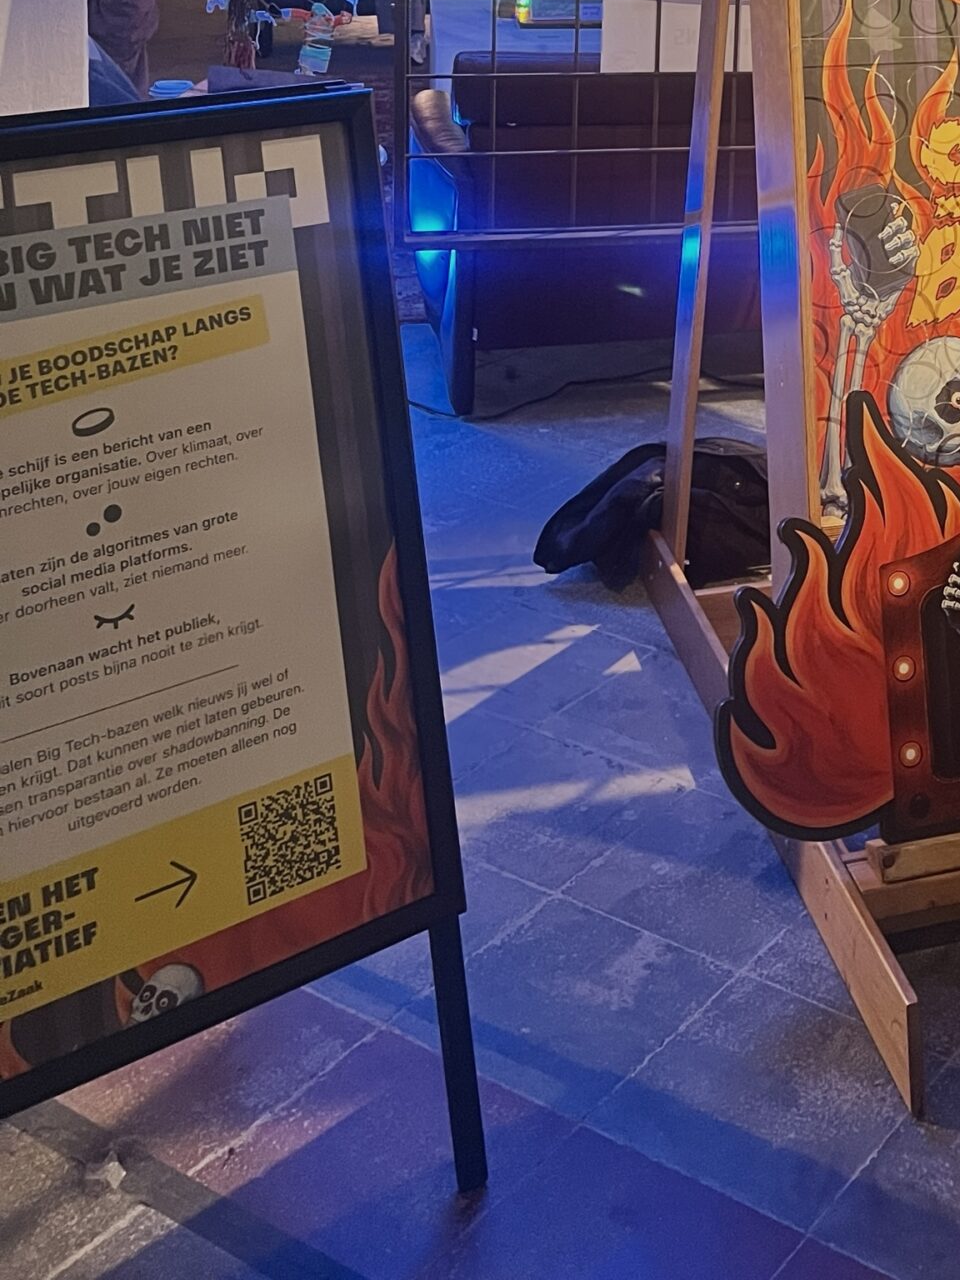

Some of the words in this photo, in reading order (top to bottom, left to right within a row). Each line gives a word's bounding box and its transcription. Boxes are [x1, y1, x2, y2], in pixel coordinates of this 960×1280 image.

[68, 223, 171, 264] TECH
[182, 208, 265, 247] NIET
[28, 263, 127, 305] WAT
[139, 254, 183, 287] JE
[193, 239, 269, 277] ZIET
[8, 363, 33, 384] JE
[38, 325, 178, 376] BOODSCHAP
[182, 306, 252, 338] LANGS
[26, 344, 179, 399] TECH-BAZEN?
[8, 455, 50, 478] schijf
[54, 452, 67, 467] is
[71, 447, 98, 463] een
[103, 432, 154, 455] bericht
[158, 427, 183, 442] van
[186, 421, 212, 436] een
[55, 456, 142, 486] organisatie.
[146, 448, 178, 463] Over
[182, 434, 233, 455] klimaat,
[236, 426, 264, 442] over
[72, 483, 103, 501] over
[106, 474, 141, 495] jouw
[144, 463, 182, 482] eigen
[184, 451, 239, 472] rechten.
[21, 574, 67, 597] social
[70, 562, 116, 584] media
[119, 542, 193, 572] platforms.
[39, 556, 66, 574] zijn
[70, 549, 89, 565] de
[92, 528, 170, 559] algoritmes
[172, 522, 199, 537] van
[201, 510, 239, 532] grote
[15, 593, 86, 619] doorheen
[89, 581, 120, 601] valt,
[123, 570, 148, 588] ziet
[151, 554, 209, 581] niemand
[212, 544, 249, 564] meer.
[8, 656, 85, 686] Bovenaan
[88, 638, 134, 663] wacht
[136, 631, 162, 648] het
[164, 612, 221, 642] publiek,
[15, 683, 55, 704] soort
[59, 669, 100, 692] posts
[103, 657, 138, 678] bijna
[140, 645, 176, 665] nooit
[179, 639, 193, 653] te
[197, 632, 224, 649] zien
[20, 766, 62, 789] krijgt.
[67, 756, 93, 773] Dat
[96, 736, 149, 762] kunnen
[152, 728, 172, 743] we
[175, 718, 202, 736] niet
[204, 705, 238, 725] laten
[240, 683, 305, 716] gebeuren.
[36, 746, 61, 764] Big
[65, 717, 150, 753] Tech-bazen
[152, 706, 185, 724] welk
[187, 689, 234, 713] nieuws
[236, 680, 248, 696] jij
[251, 676, 273, 691] wel
[276, 668, 290, 683] of
[8, 804, 69, 834] hiervoor
[74, 781, 132, 810] bestaan
[135, 774, 152, 789] al.
[155, 767, 173, 781] Ze
[177, 745, 228, 773] moeten
[230, 733, 270, 754] alleen
[272, 721, 298, 740] nog
[28, 763, 125, 808] transparantie
[127, 753, 157, 772] over
[162, 713, 269, 759] shadowbanning.
[272, 705, 291, 720] De
[67, 796, 143, 833] uitgevoerd
[146, 775, 202, 802] worden.
[41, 867, 100, 908] HET
[0, 910, 76, 950] GER-
